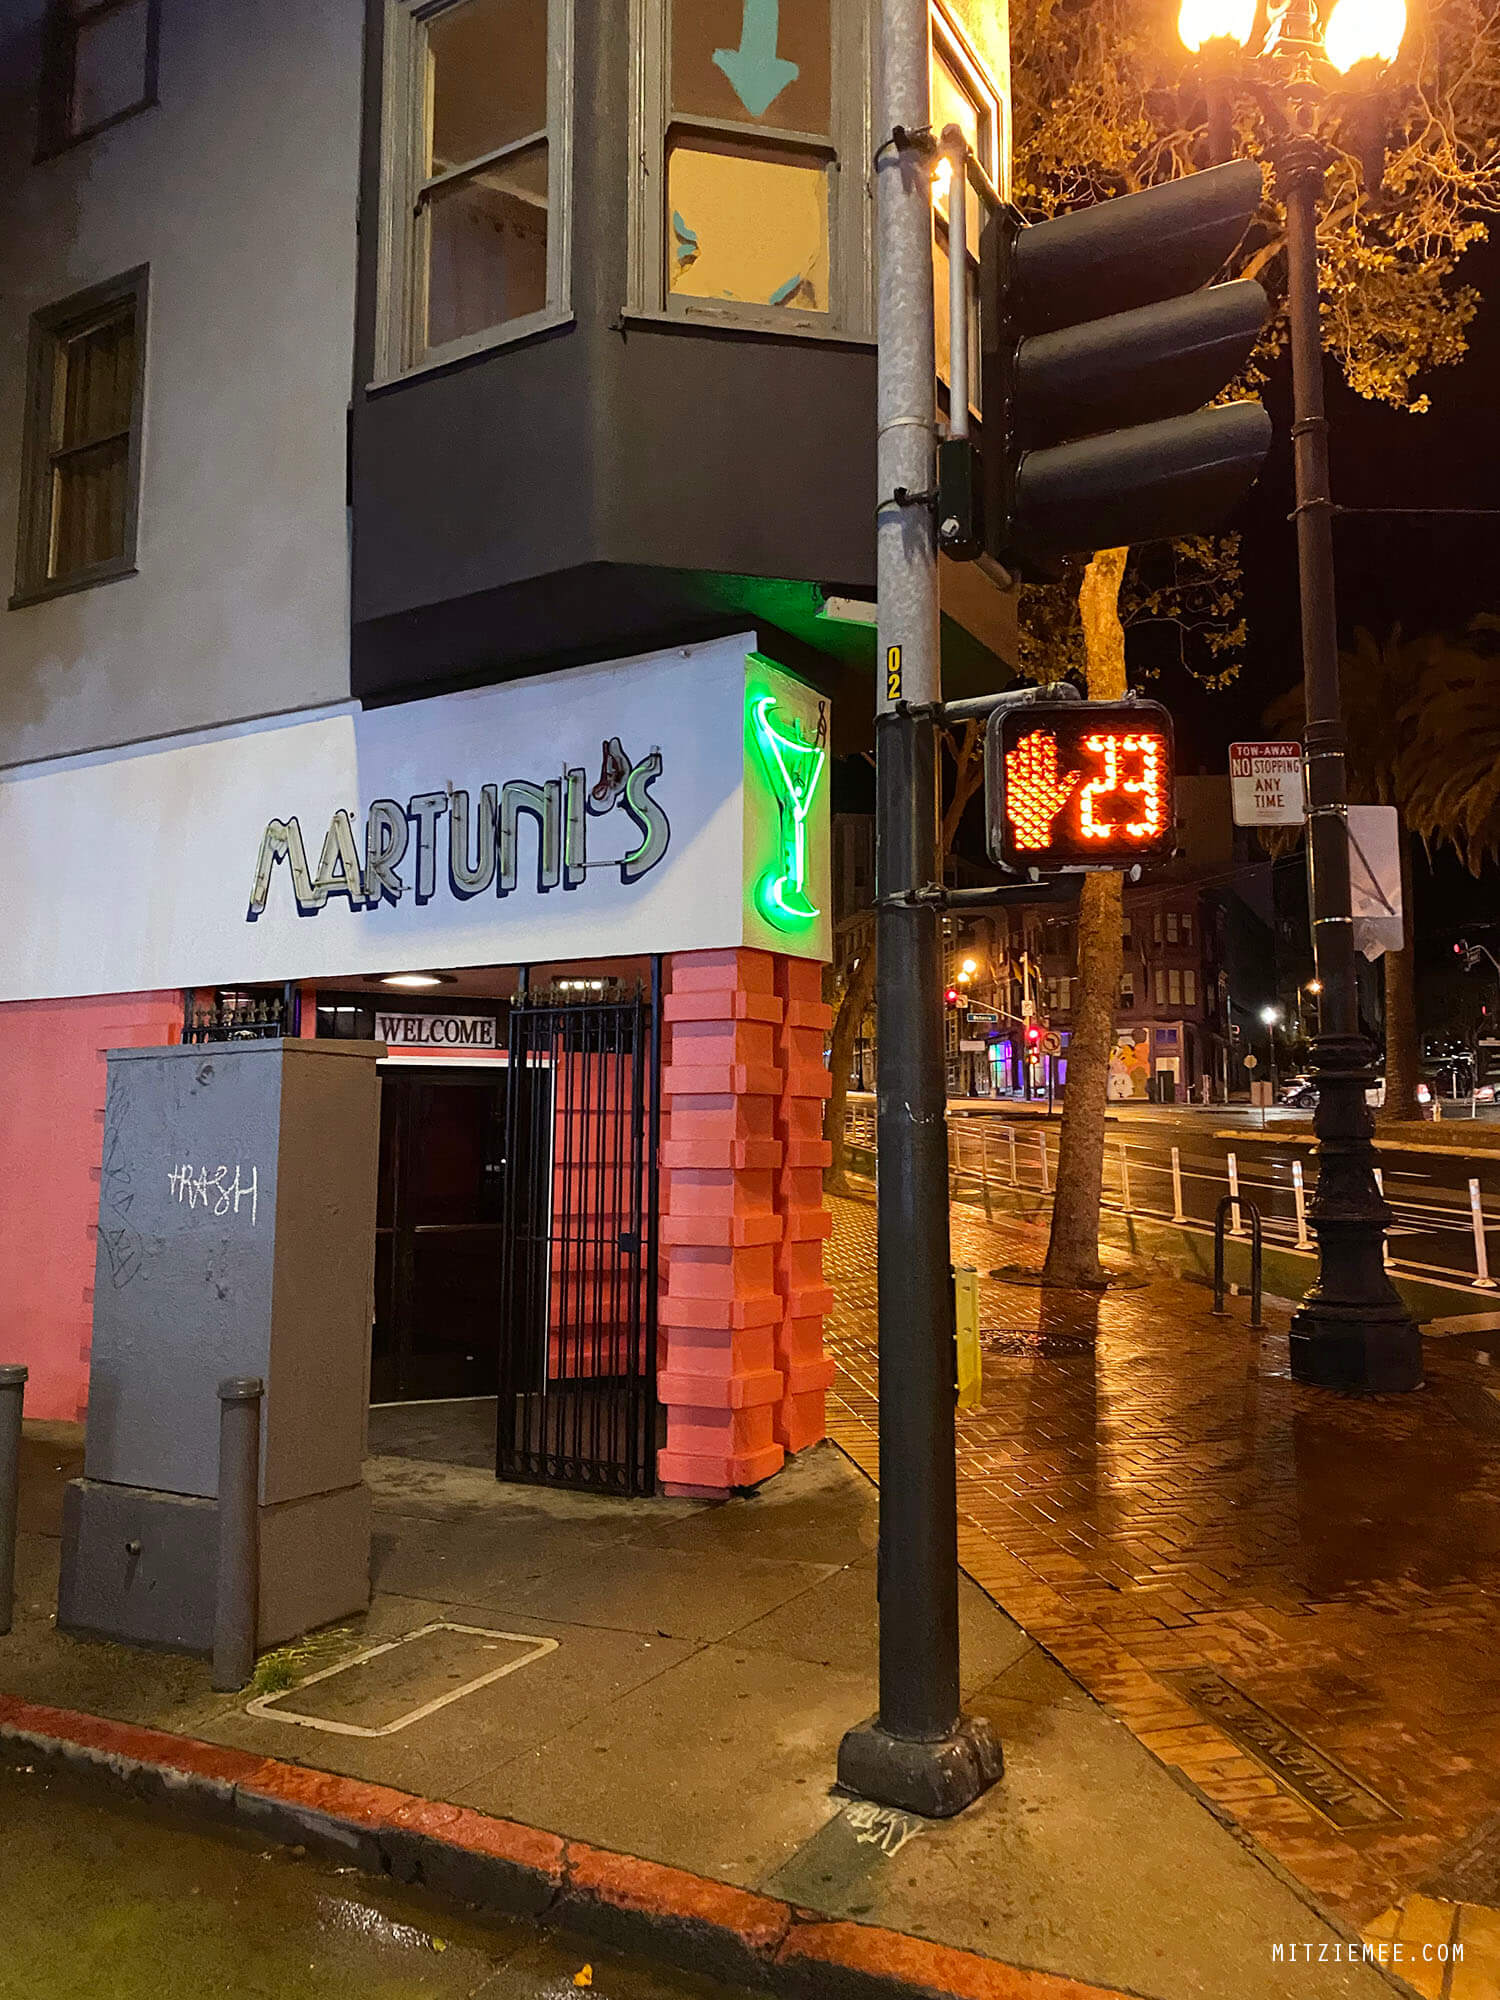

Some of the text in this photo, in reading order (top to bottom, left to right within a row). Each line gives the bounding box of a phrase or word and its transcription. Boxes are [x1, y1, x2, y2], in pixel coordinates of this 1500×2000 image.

[1236, 746, 1294, 756] TOW-AWAY
[1232, 758, 1300, 777] NO STOPPING
[1080, 734, 1168, 839] 23
[1255, 779, 1281, 792] ANY
[1254, 794, 1285, 808] TIME
[246, 737, 670, 922] MARTUNI'S
[379, 1016, 493, 1044] WELCOME
